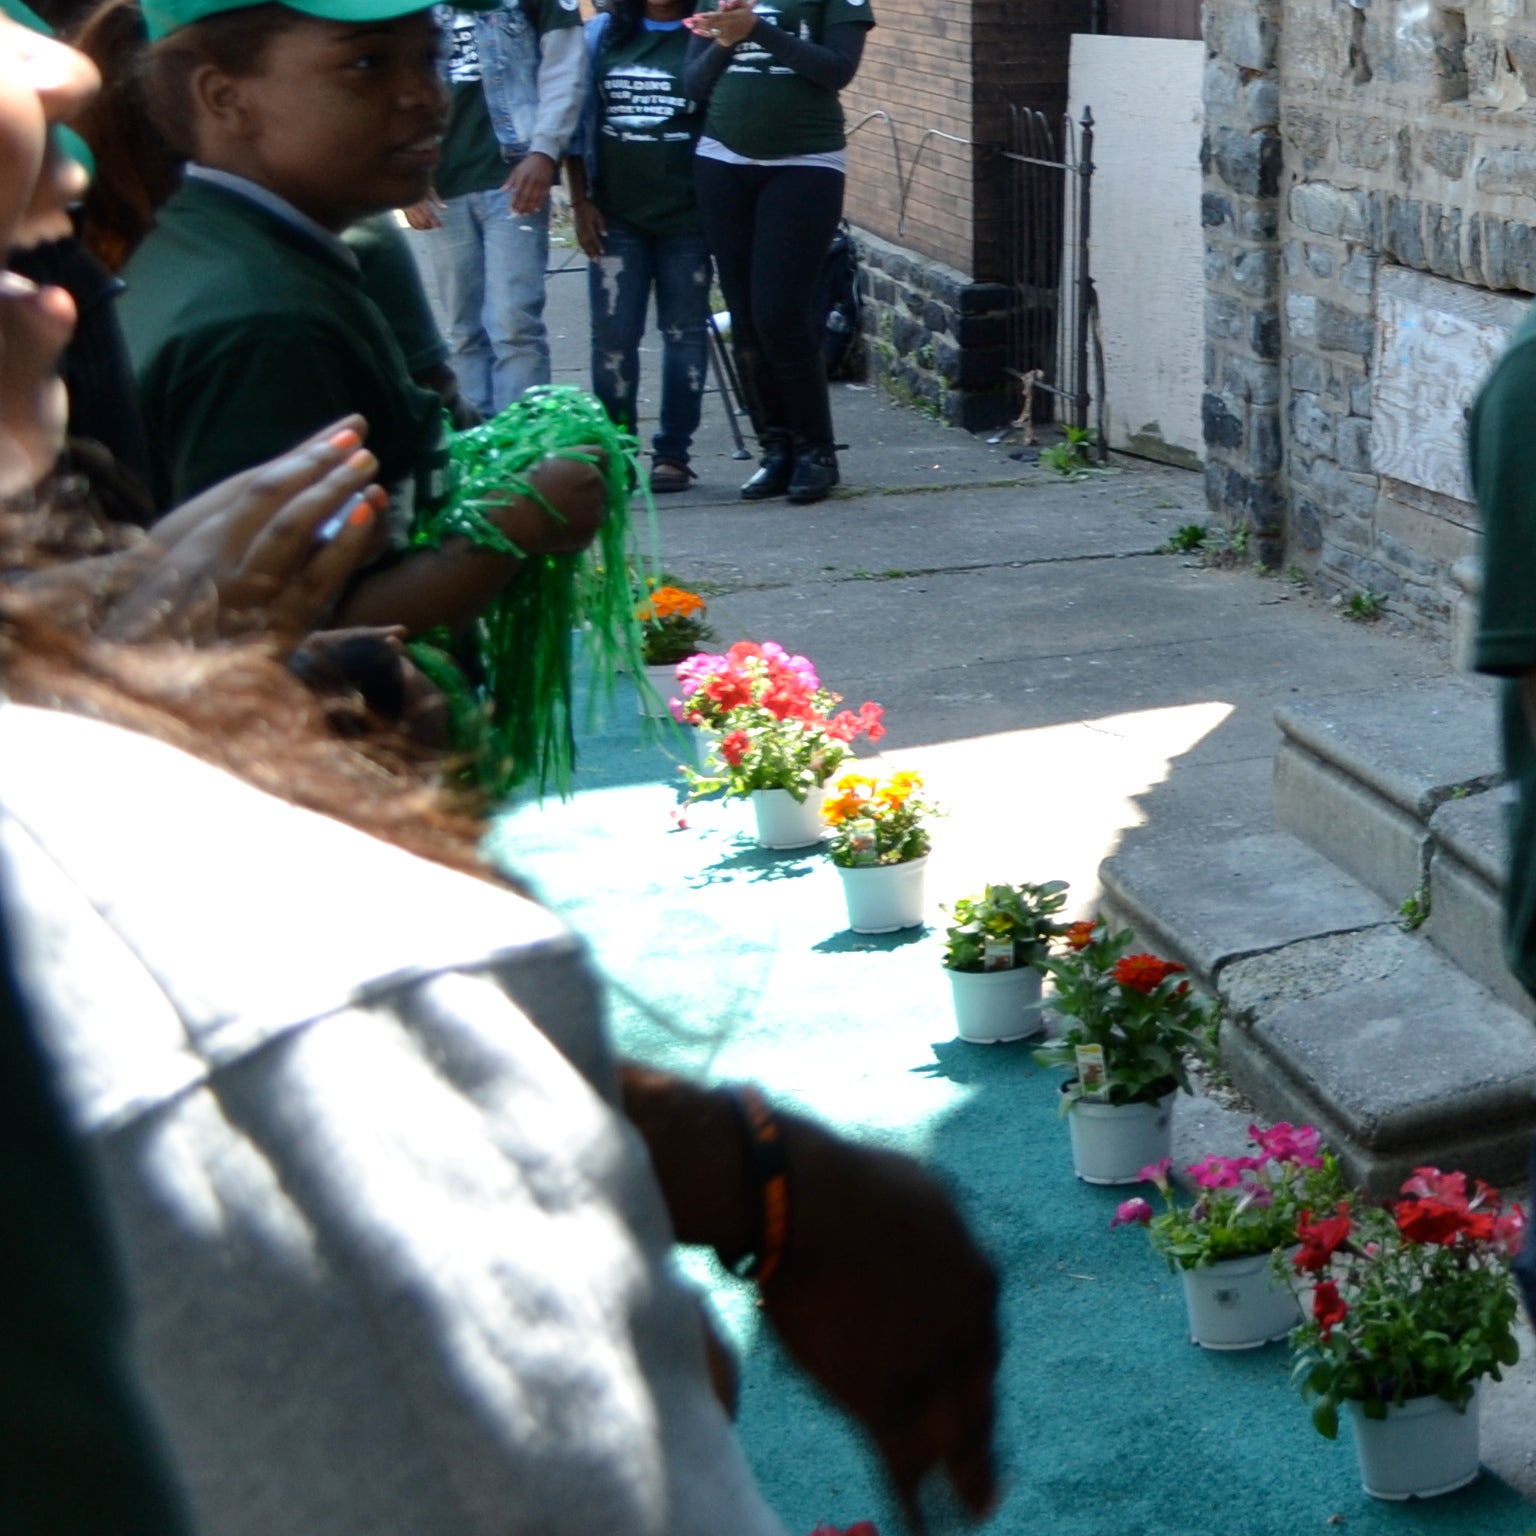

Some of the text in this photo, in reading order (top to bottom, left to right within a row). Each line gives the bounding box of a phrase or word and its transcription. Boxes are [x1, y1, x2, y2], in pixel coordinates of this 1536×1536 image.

[604, 79, 672, 91] BUILDING
[609, 90, 686, 107] OUR FUTURE
[606, 105, 674, 116] TOGETHER
